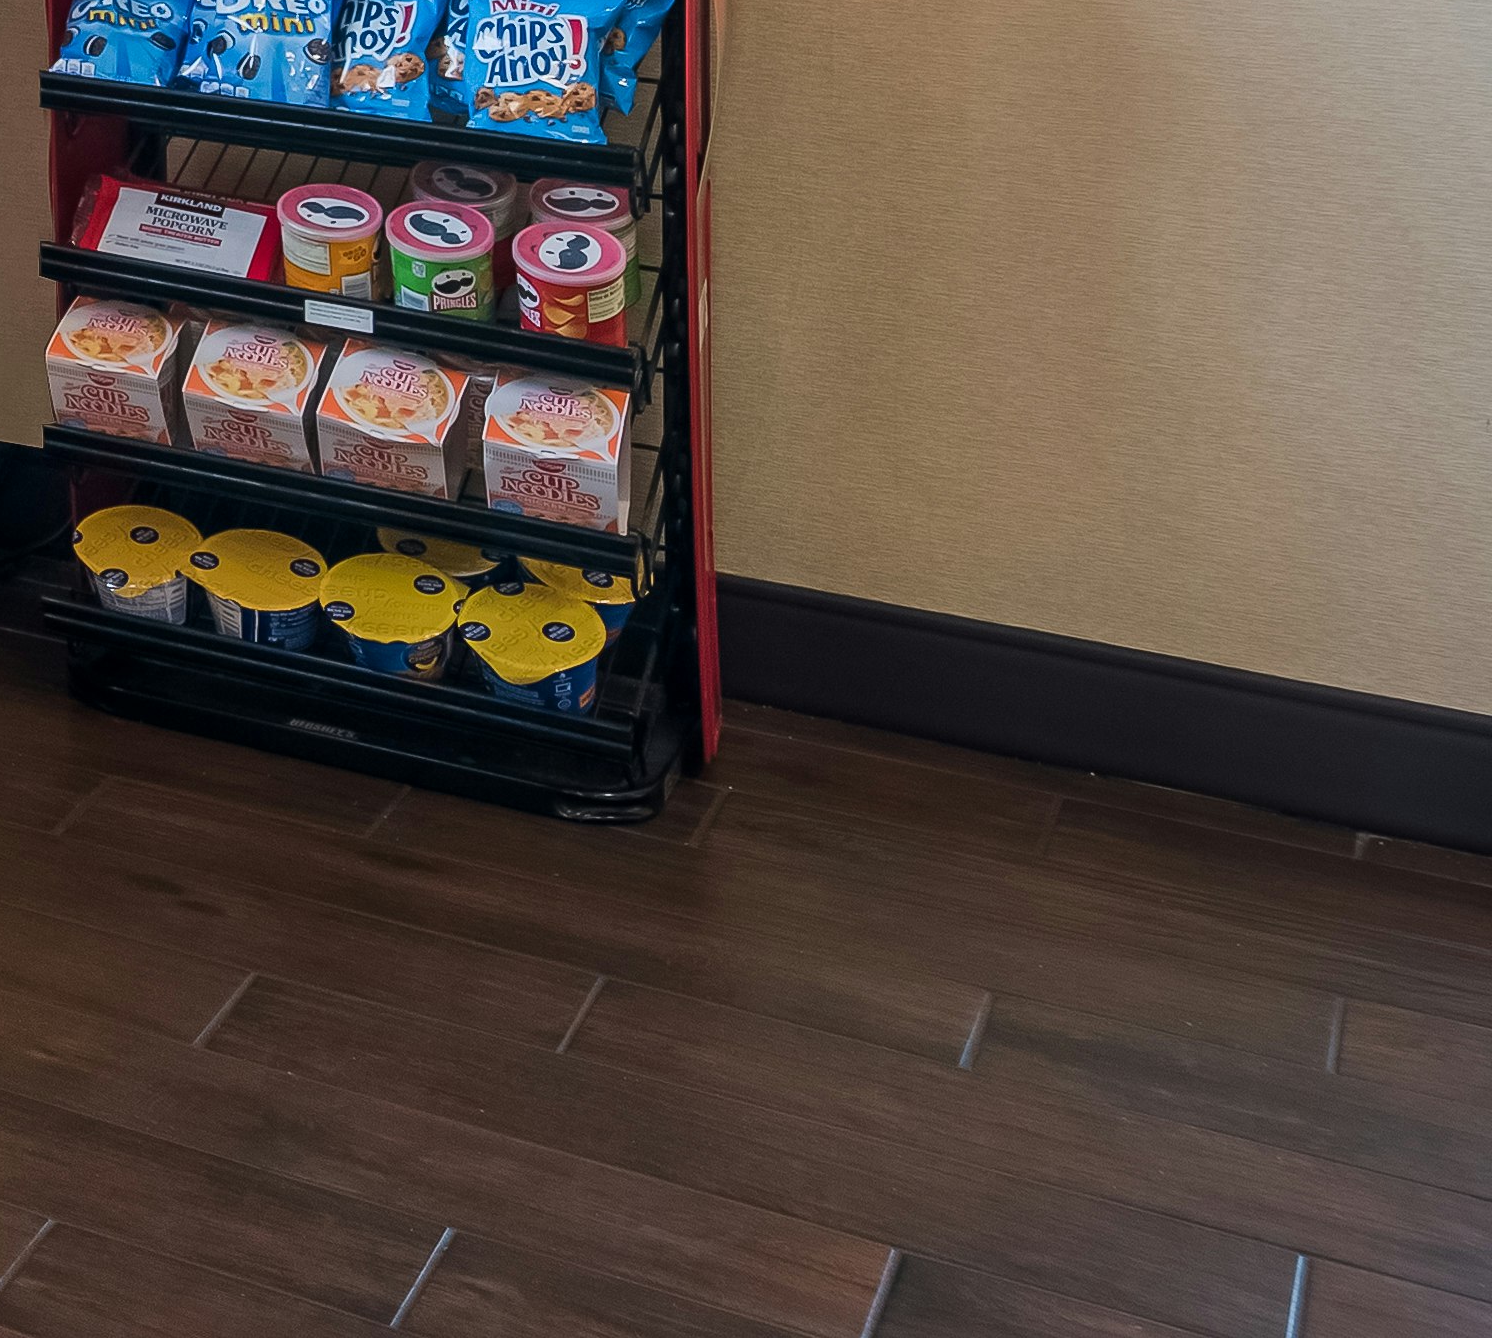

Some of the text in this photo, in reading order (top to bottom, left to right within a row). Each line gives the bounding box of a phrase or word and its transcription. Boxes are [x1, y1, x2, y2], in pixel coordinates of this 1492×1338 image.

[238, 12, 316, 35] mini
[475, 15, 565, 61] Chips
[159, 193, 224, 213] KIRKLAND
[146, 205, 229, 231] MICROWAVE
[151, 216, 216, 237] POPCORN
[432, 291, 478, 311] PRINGLES
[224, 347, 289, 370] NOODLES
[242, 342, 279, 356] CUP
[361, 370, 429, 399] NOODLES
[381, 367, 421, 384] CUP
[80, 384, 129, 405] CUP
[538, 393, 581, 409] CUP
[64, 392, 151, 423] NOODLES
[520, 397, 593, 420] NOODLES
[203, 423, 293, 458] NOODLES
[221, 419, 273, 441] CUP
[353, 442, 408, 464] CUP
[334, 449, 428, 481] NOODLES
[523, 469, 581, 492] CUP
[500, 477, 602, 511] NOODLES
